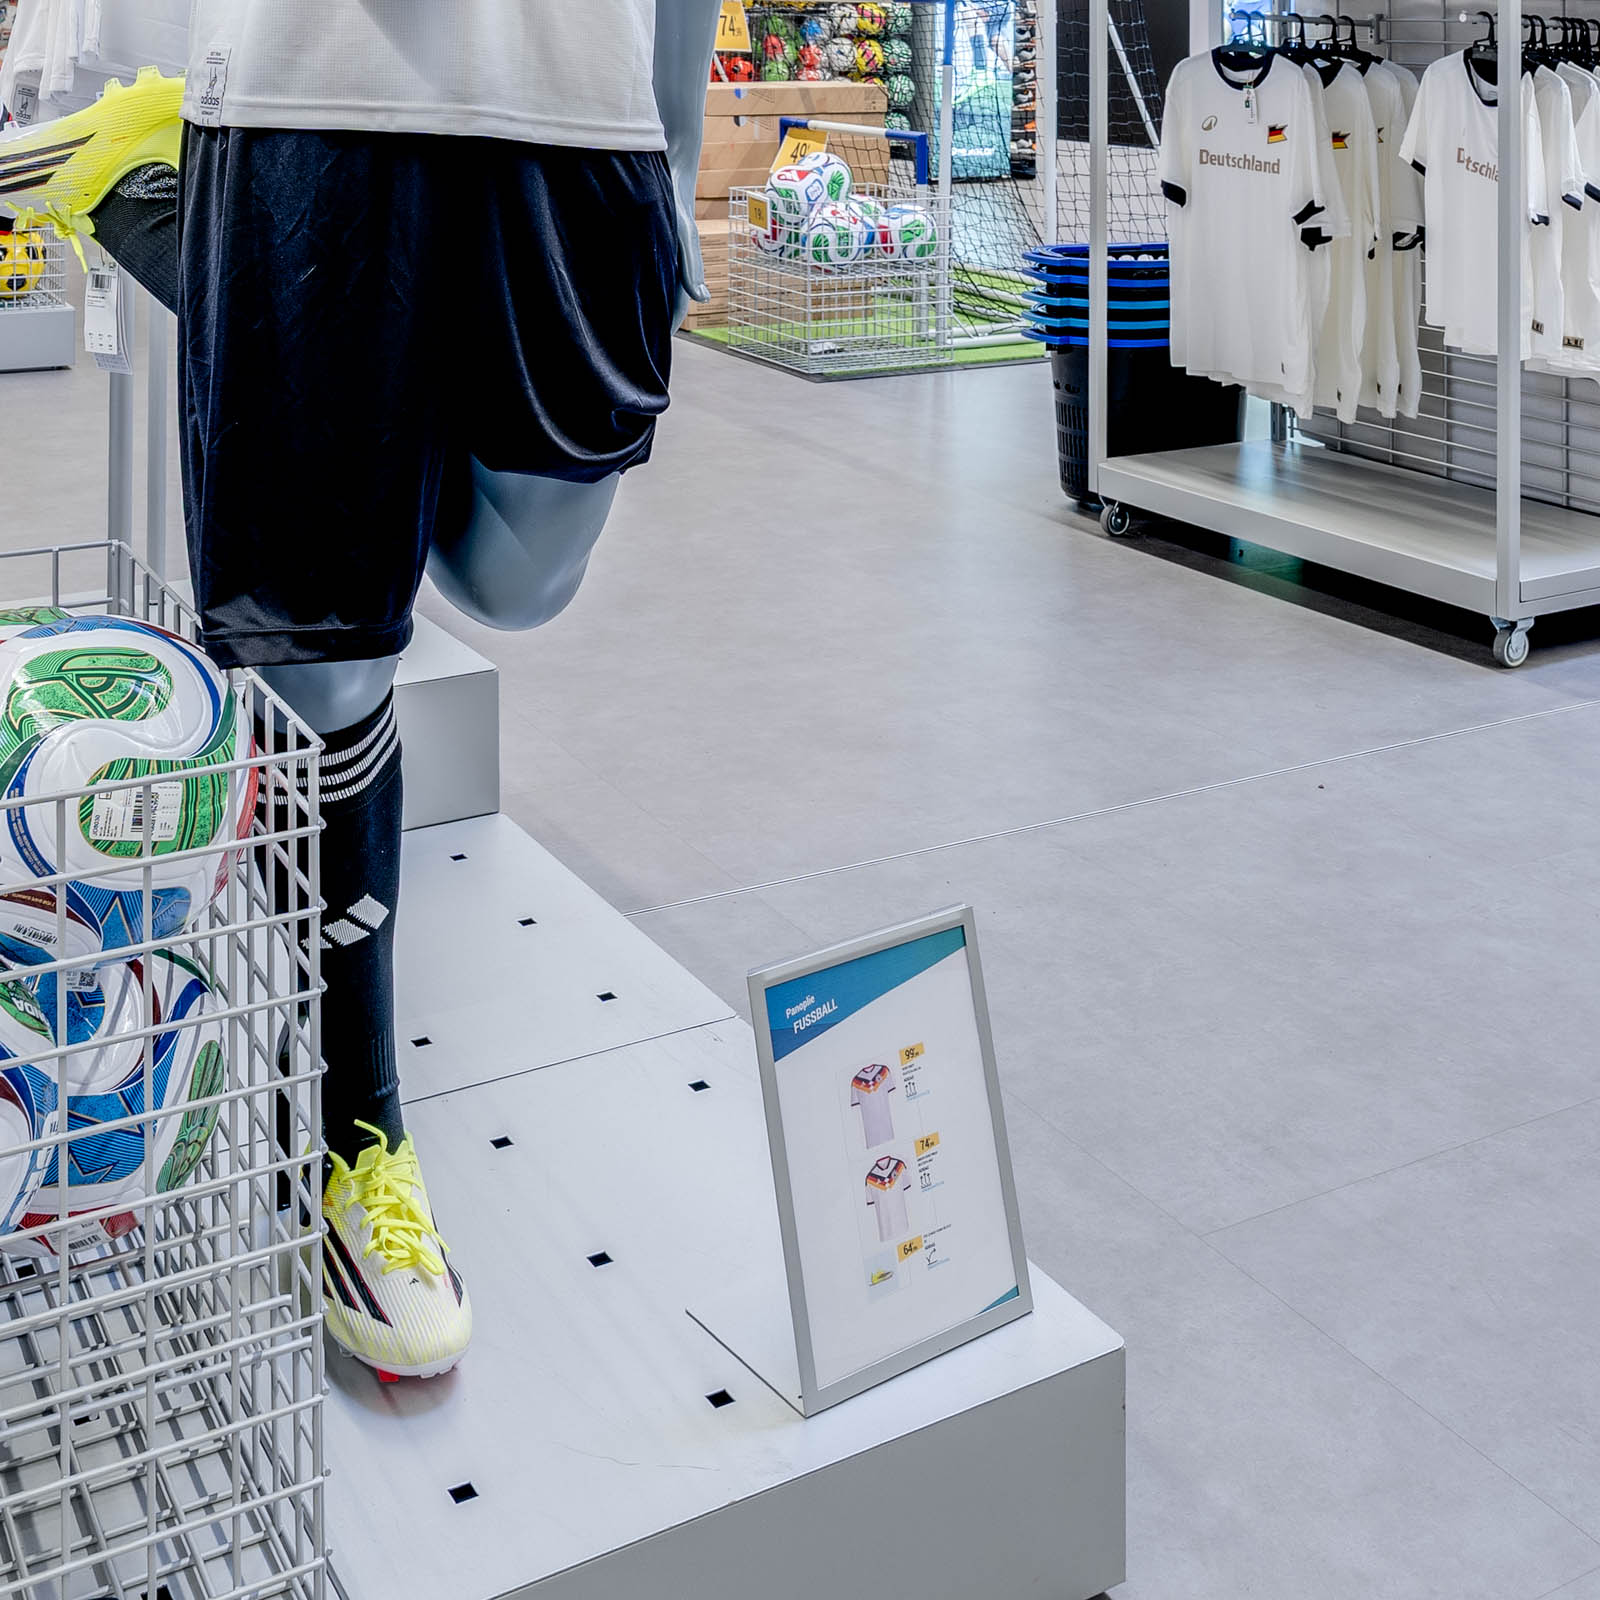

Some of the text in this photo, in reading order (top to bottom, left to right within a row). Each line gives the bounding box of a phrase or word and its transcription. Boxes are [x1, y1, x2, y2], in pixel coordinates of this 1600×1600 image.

[1199, 149, 1280, 175] Deutschland
[786, 994, 816, 1019] Panoplie
[793, 999, 838, 1034] FUSSBALL
